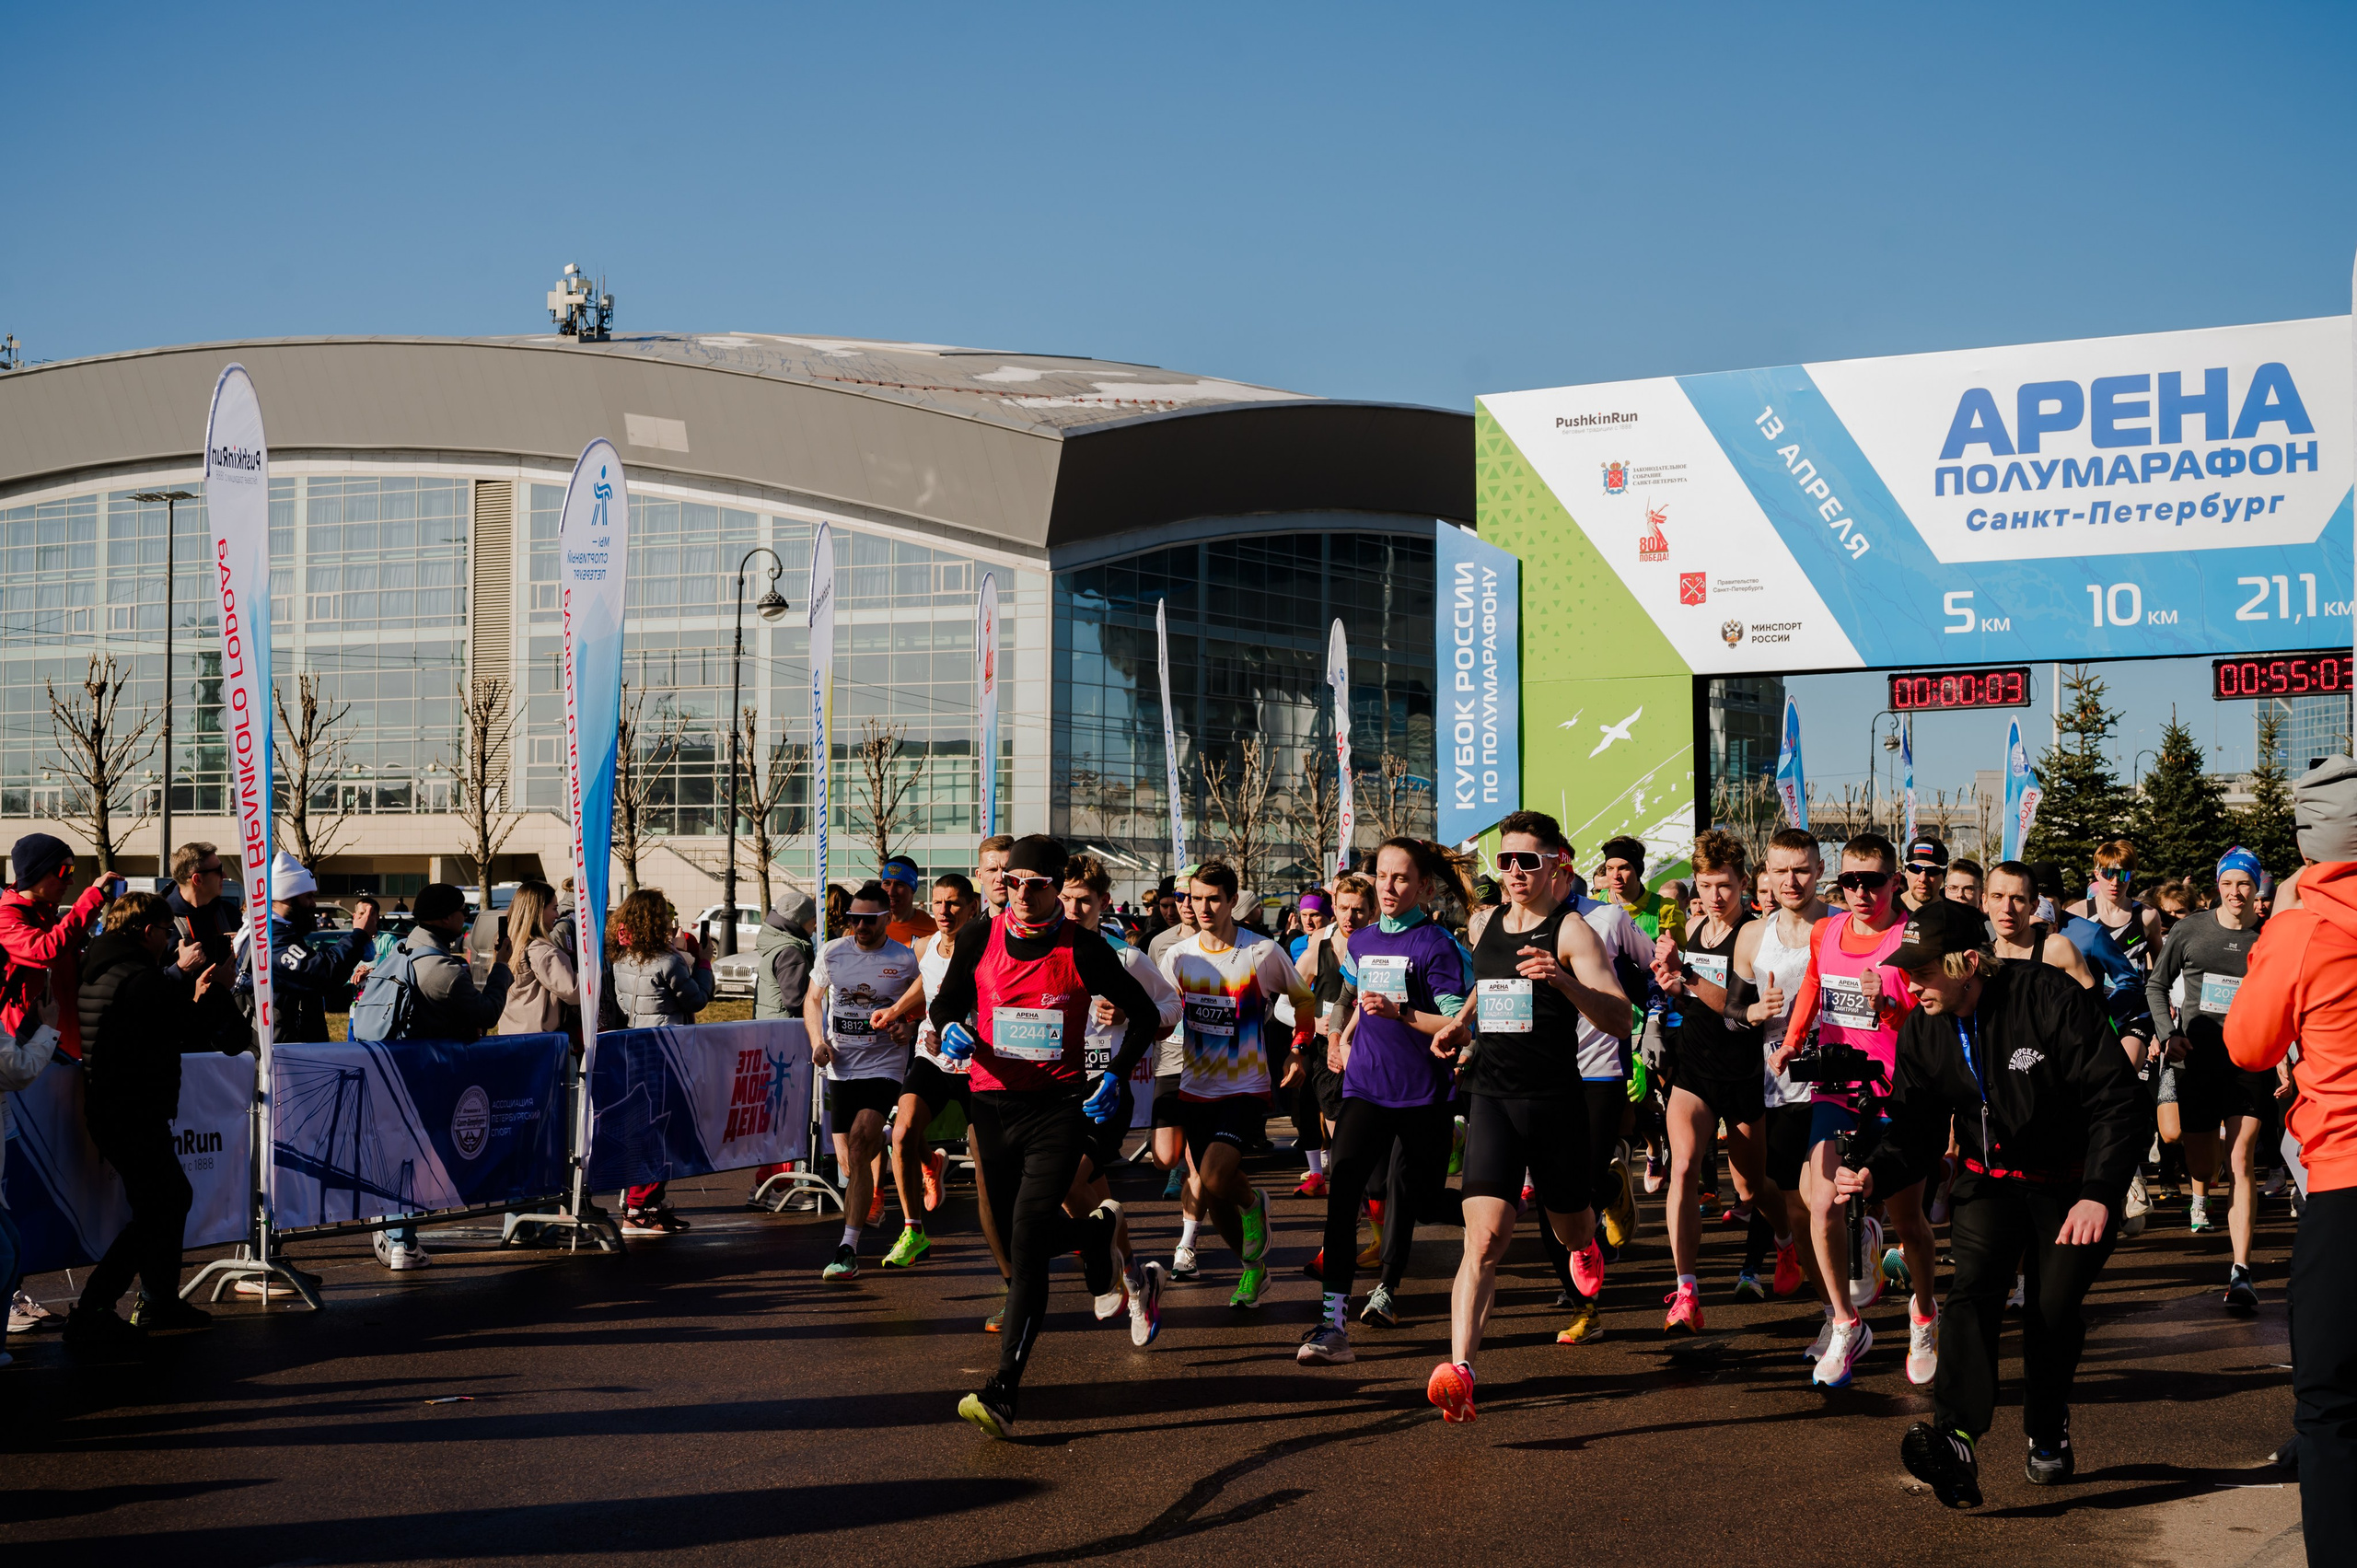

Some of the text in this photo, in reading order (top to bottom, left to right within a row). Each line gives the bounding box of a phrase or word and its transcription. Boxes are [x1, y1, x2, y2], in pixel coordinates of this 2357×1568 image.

[1938, 362, 2316, 460] АРЕНА
[1556, 412, 1638, 427] PushkinRun
[1632, 464, 1688, 473] ЗАКОНОДАТЕЛЬНОЕ
[1934, 440, 2318, 496] ПОЛУМАРАФОН
[1632, 478, 1688, 486] САНКТ-ПЕТЕРБУРГА
[1755, 405, 1870, 560] 13 АПРЕЛЯ
[1966, 492, 2285, 531] Санкт-Петербург
[1639, 537, 1657, 552] 80
[1639, 552, 1669, 562] ПОБЕДА!
[1713, 585, 1763, 593] Санкт-Петербурга
[2085, 582, 2178, 627] 10 КМ
[2235, 573, 2354, 624] 21,1 КМ
[1943, 590, 2011, 633] 5 КМ
[1454, 562, 1475, 691] РОССИИ
[1751, 621, 1802, 632] МИНСПОРТ
[1751, 634, 1790, 644] РОССИИ
[1481, 566, 1498, 765] ПОЛУМАРАФОНУ
[1895, 672, 2023, 708] 00:00:03
[1454, 698, 1476, 809] КУБОК
[1482, 770, 1498, 803] ПО
[280, 944, 307, 970] 30
[1368, 971, 1390, 983] 1212
[1831, 992, 1864, 1009] 3752
[2213, 987, 2237, 999] 205
[1483, 997, 1515, 1011] 1760
[1833, 1005, 1859, 1013] ДМИТРИЙ
[1195, 1006, 1223, 1019] 4077
[842, 1019, 864, 1030] 3812
[1009, 1025, 1046, 1040] 2244
[736, 1049, 762, 1074] ЭТО
[730, 1063, 772, 1107] МОЙ
[492, 1098, 534, 1109] АССОЦИАЦИЯ
[491, 1109, 540, 1123] ПЕТЕРБУРГСКИЙ
[722, 1104, 772, 1144] ДЕНЬ
[491, 1127, 512, 1137] СПОРТ
[194, 1157, 215, 1171] 1888
